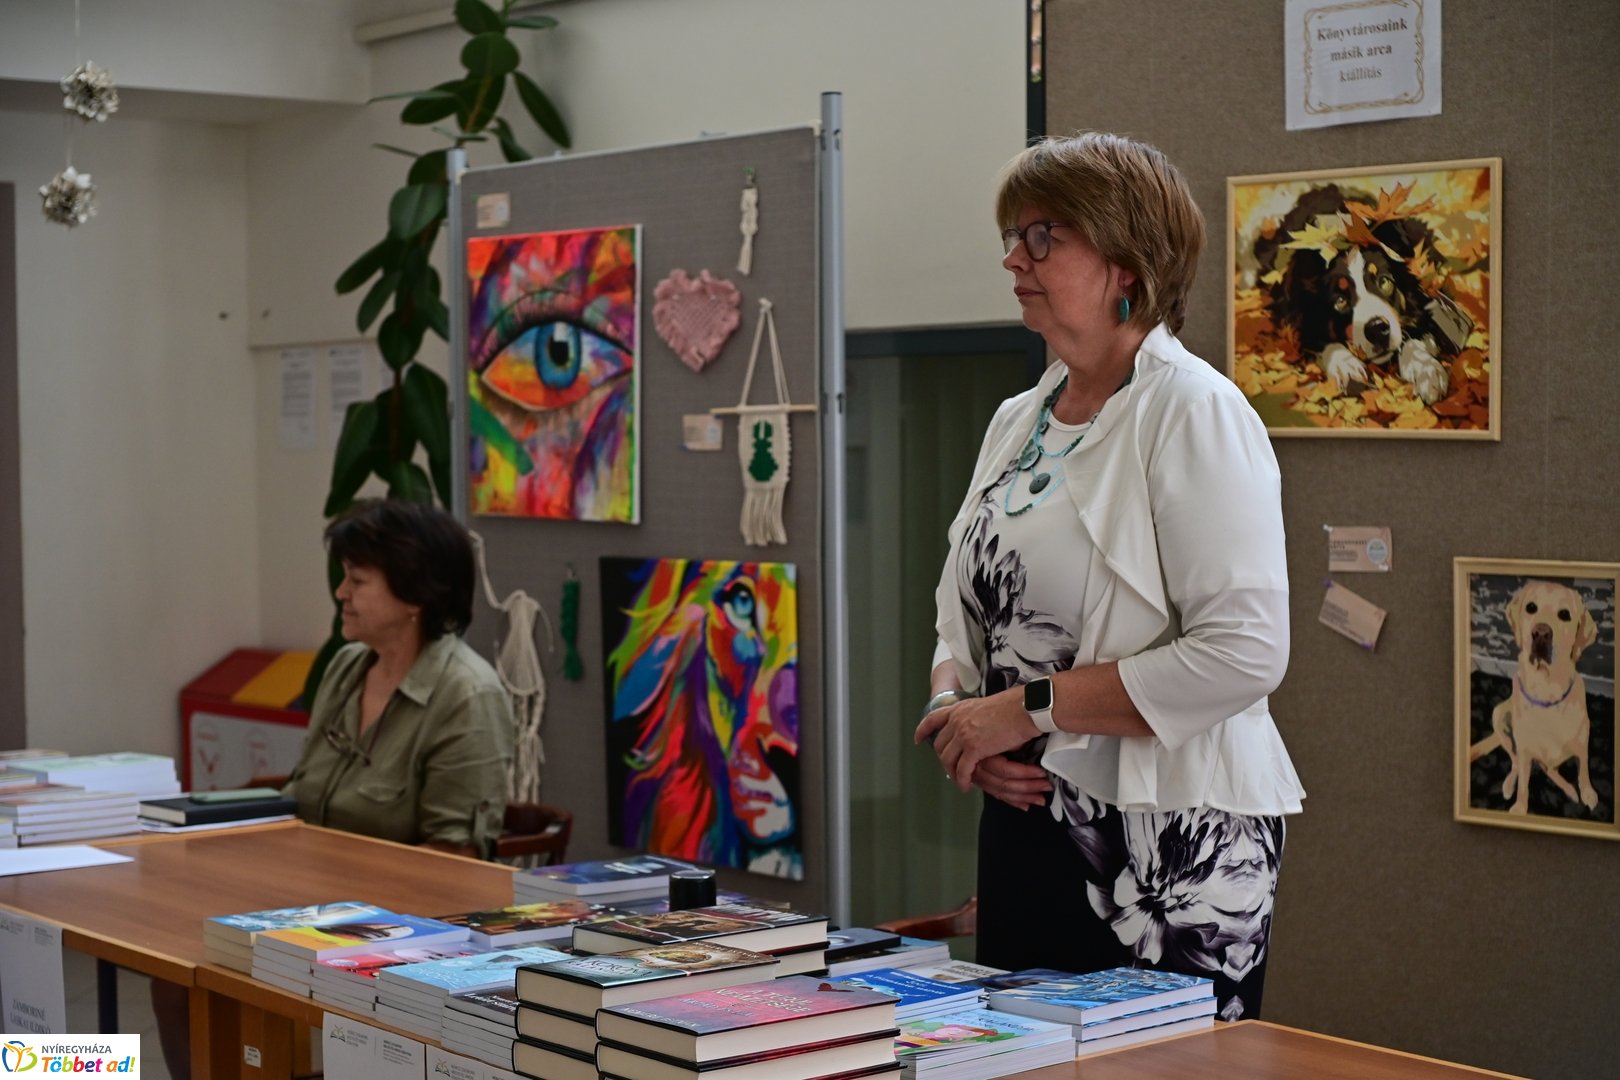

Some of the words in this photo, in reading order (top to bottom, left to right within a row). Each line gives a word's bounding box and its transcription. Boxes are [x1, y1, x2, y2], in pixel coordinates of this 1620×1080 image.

[1317, 17, 1408, 41] Könyvtárosaink
[1330, 46, 1364, 61] másik
[1367, 44, 1393, 57] arca
[1340, 66, 1383, 82] kiállítás
